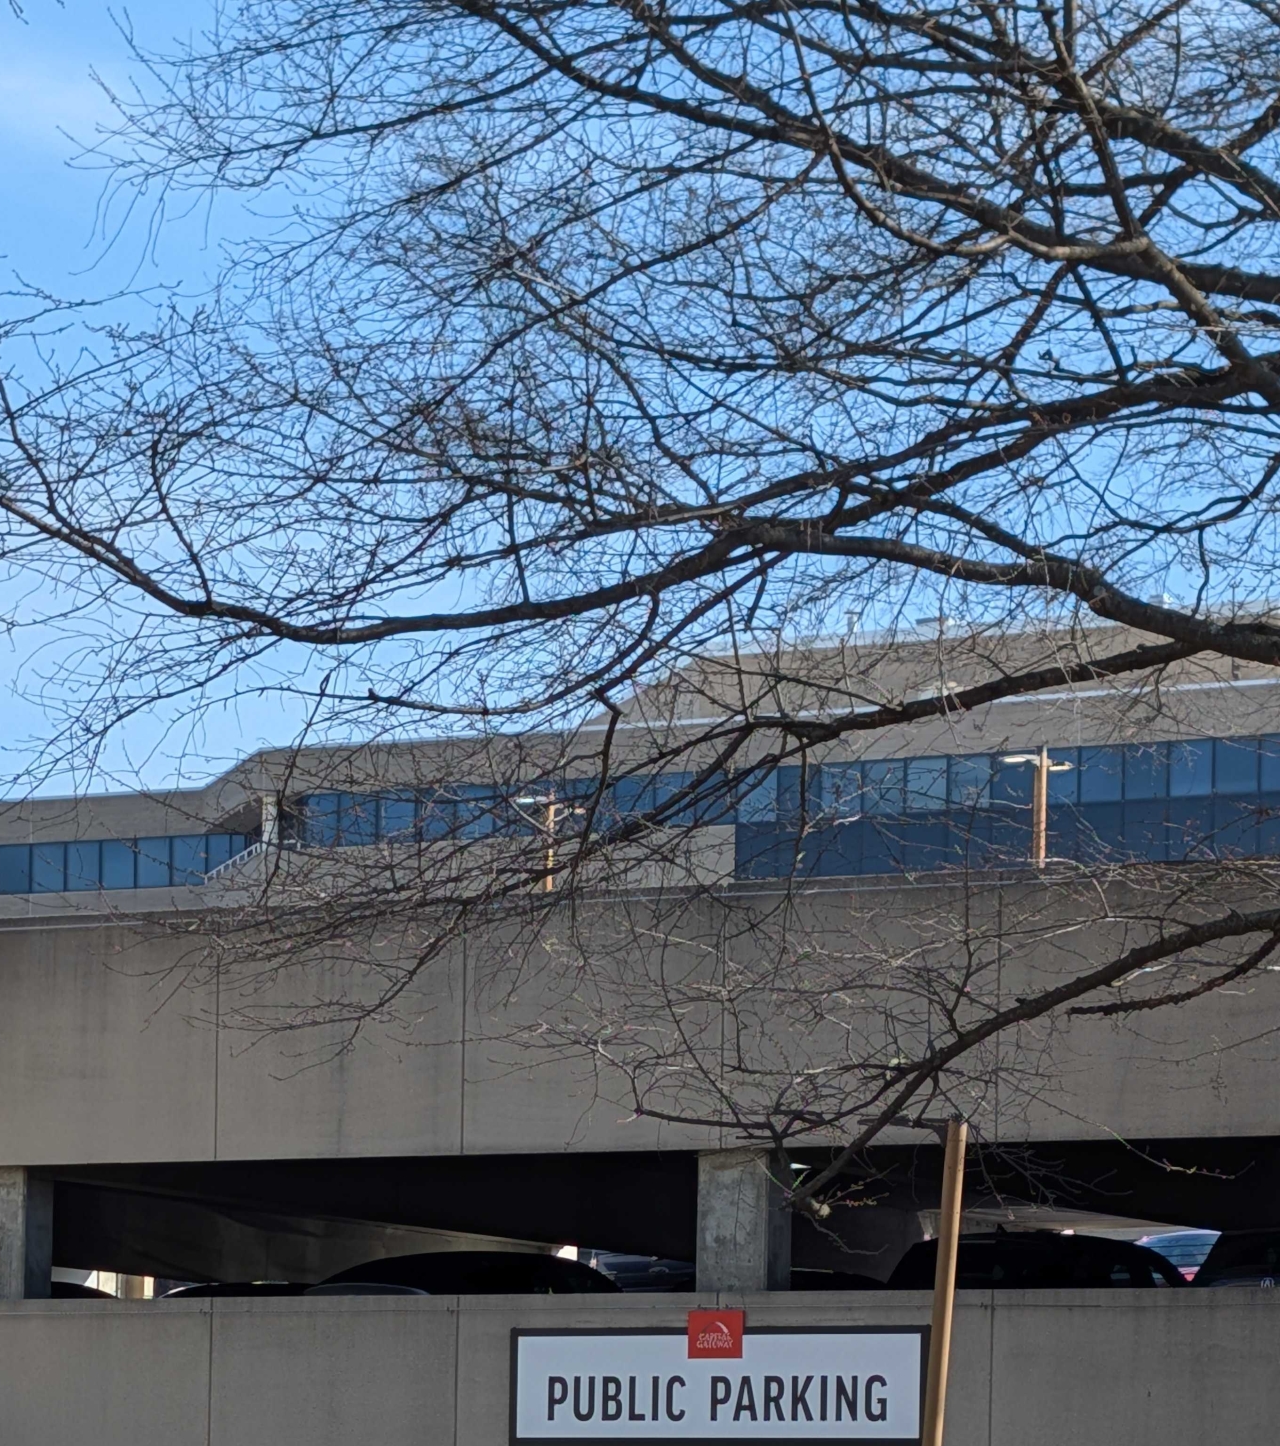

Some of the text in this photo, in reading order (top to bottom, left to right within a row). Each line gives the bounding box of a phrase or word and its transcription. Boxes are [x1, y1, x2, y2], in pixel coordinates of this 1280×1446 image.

[696, 1340, 734, 1349] GATEWAY
[547, 1375, 888, 1422] PUBLIC PARKING
